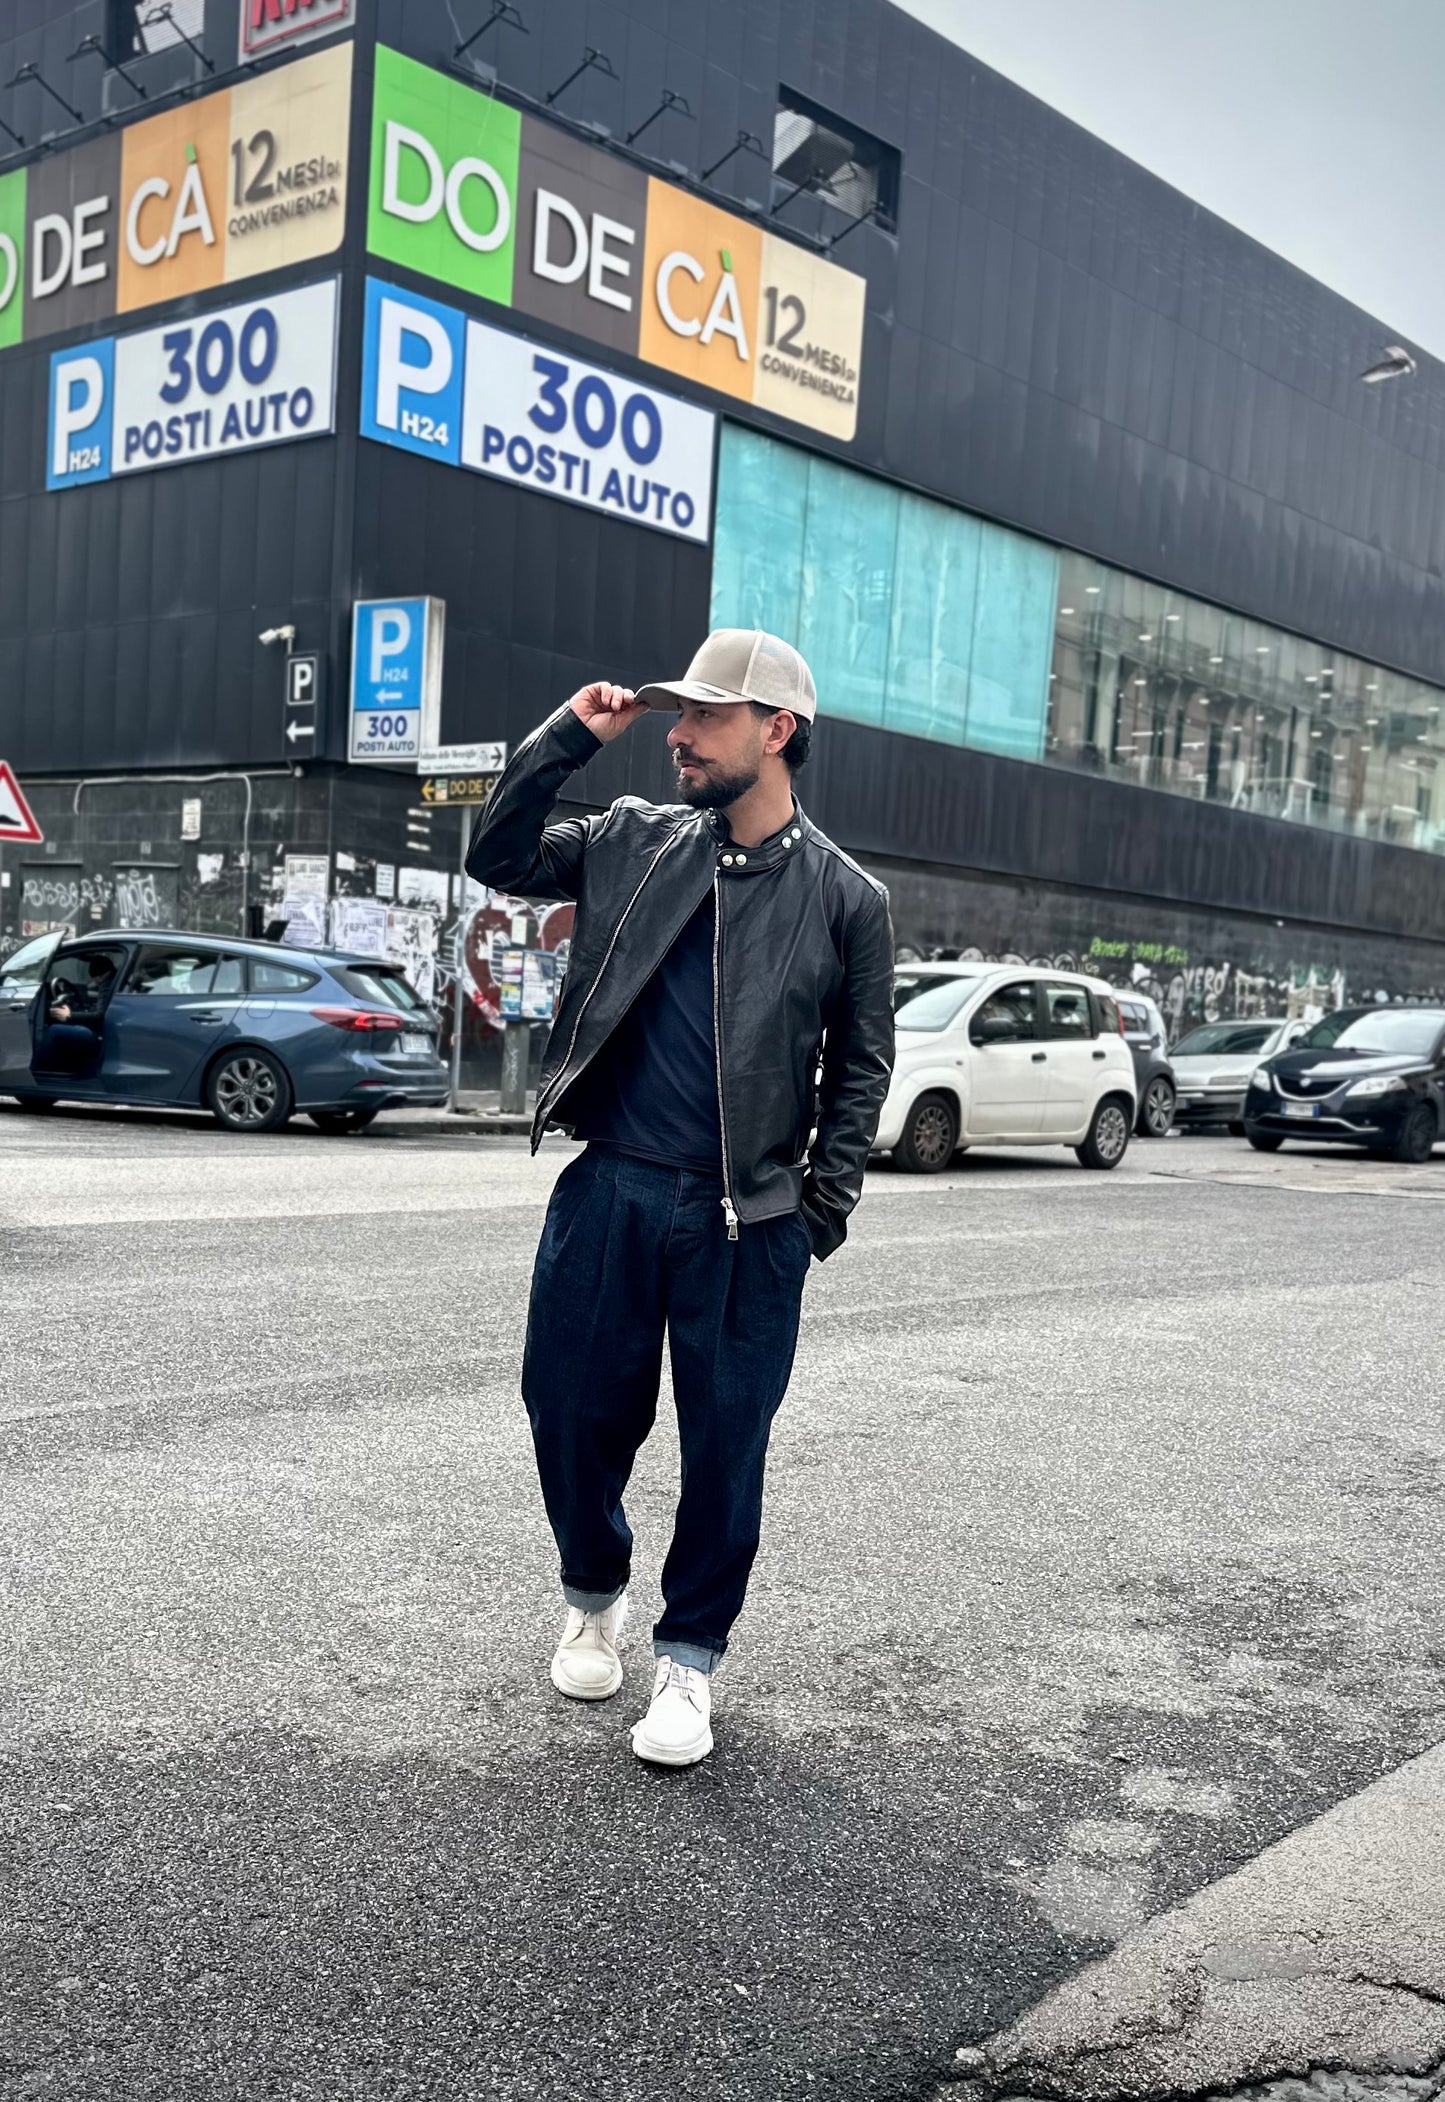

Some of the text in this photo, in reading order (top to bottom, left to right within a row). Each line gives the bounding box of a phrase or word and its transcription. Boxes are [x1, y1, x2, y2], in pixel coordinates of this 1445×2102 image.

[231, 129, 275, 207] 12
[276, 155, 325, 194] MESI
[32, 195, 109, 299] DE
[125, 141, 216, 266] CÀ
[228, 186, 340, 238] CONVENIENZA
[382, 119, 749, 361] DO DE CÀ
[159, 307, 278, 404] 300
[376, 297, 453, 430] P
[765, 286, 806, 358] 12
[805, 341, 847, 378] MESI
[53, 356, 103, 476] P
[527, 354, 662, 465] 300
[761, 353, 855, 404] CONVENIENZA
[69, 445, 101, 472] H24
[124, 386, 314, 462] POSTI AUTO
[402, 410, 449, 447] H24
[482, 424, 695, 528] POSTI AUTO
[294, 663, 312, 700] P
[369, 608, 411, 683] P
[383, 667, 409, 683] H24
[357, 740, 415, 752] POSTI AUTO
[367, 715, 408, 738] 300
[450, 780, 467, 795] DO
[469, 779, 483, 794] DE
